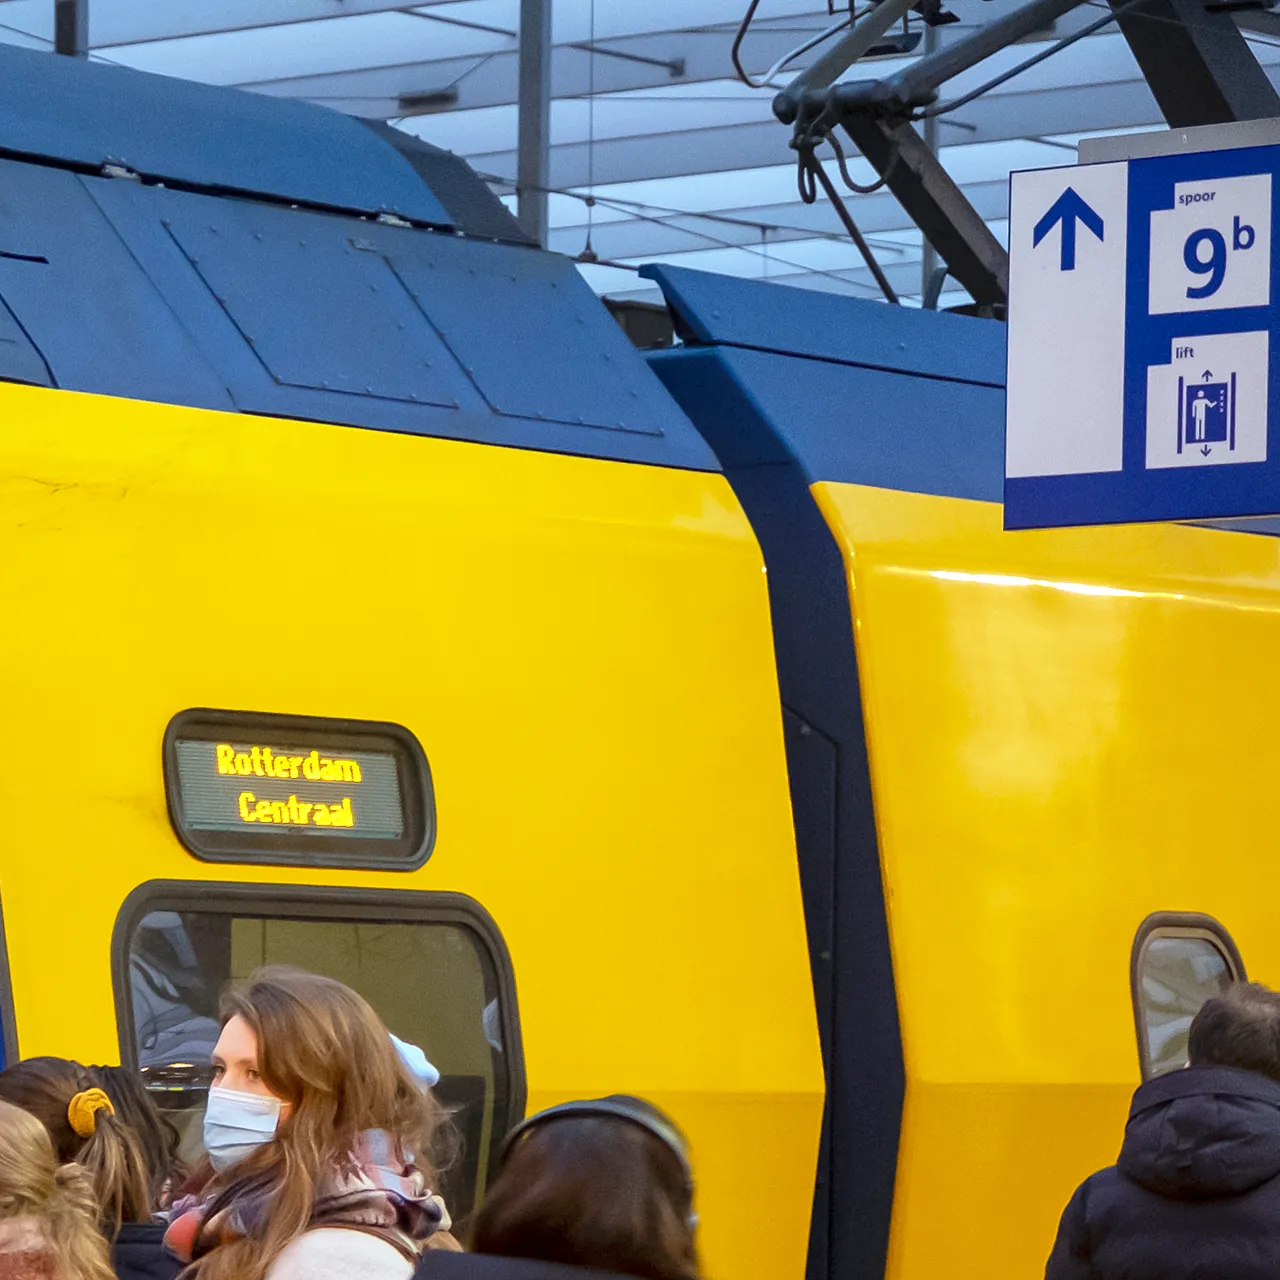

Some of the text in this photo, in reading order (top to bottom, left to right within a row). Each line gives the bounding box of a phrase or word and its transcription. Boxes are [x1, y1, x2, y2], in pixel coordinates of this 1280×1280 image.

[1179, 192, 1216, 206] spoor
[1175, 346, 1194, 359] lift
[216, 744, 362, 783] Rotterdam
[238, 791, 355, 828] Centraal
